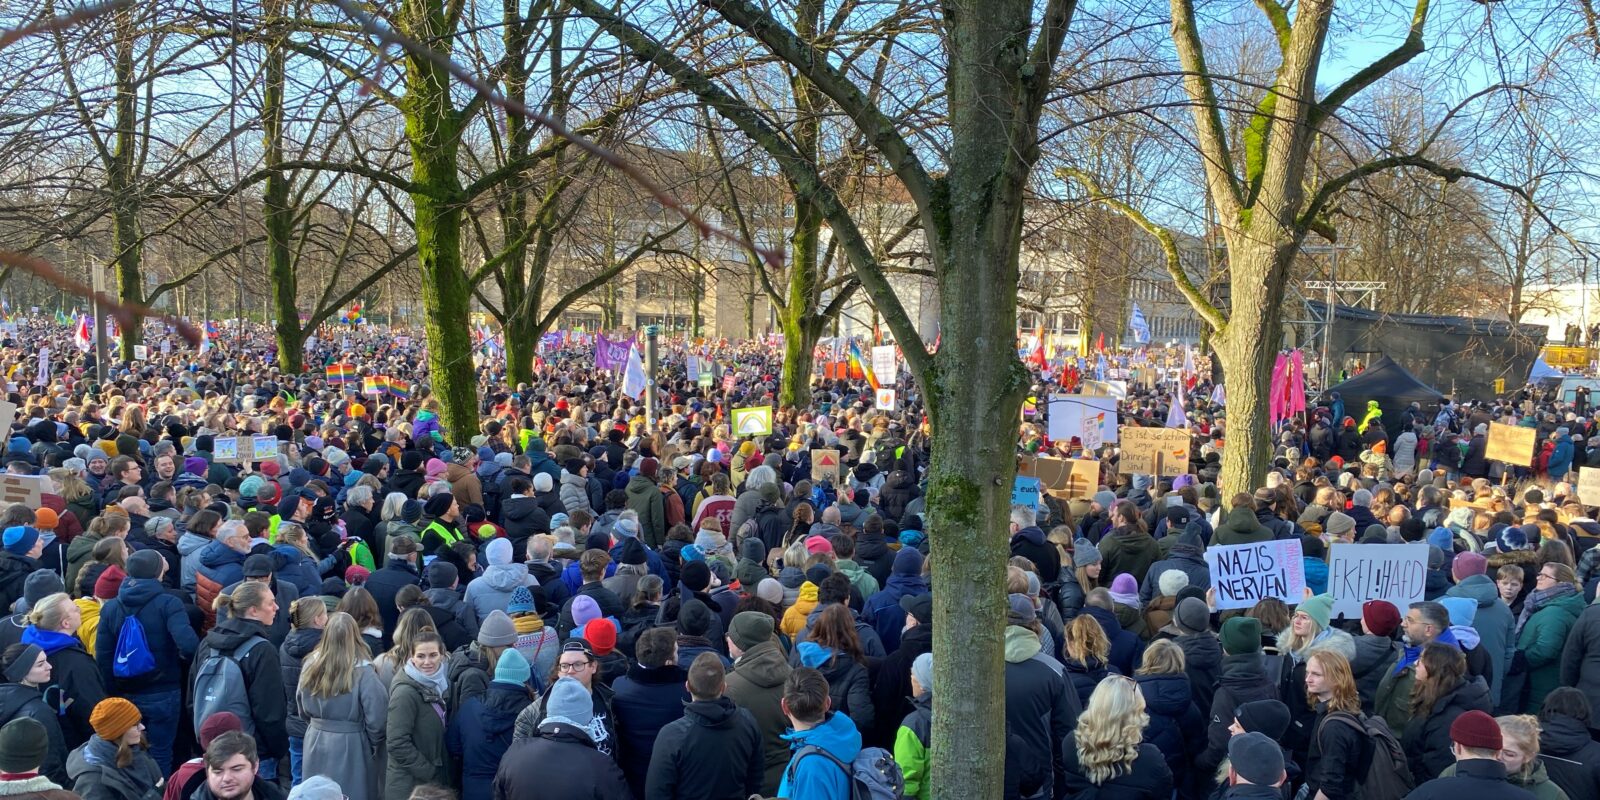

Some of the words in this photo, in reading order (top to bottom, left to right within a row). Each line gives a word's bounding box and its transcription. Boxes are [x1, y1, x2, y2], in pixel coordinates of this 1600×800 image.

[1124, 428, 1133, 439] Es
[1136, 430, 1148, 440] ist
[1134, 442, 1153, 452] sogar
[1162, 441, 1174, 450] die
[1164, 464, 1181, 473] hier
[1217, 545, 1274, 577] NAZIS
[1218, 568, 1287, 601] NERVEN
